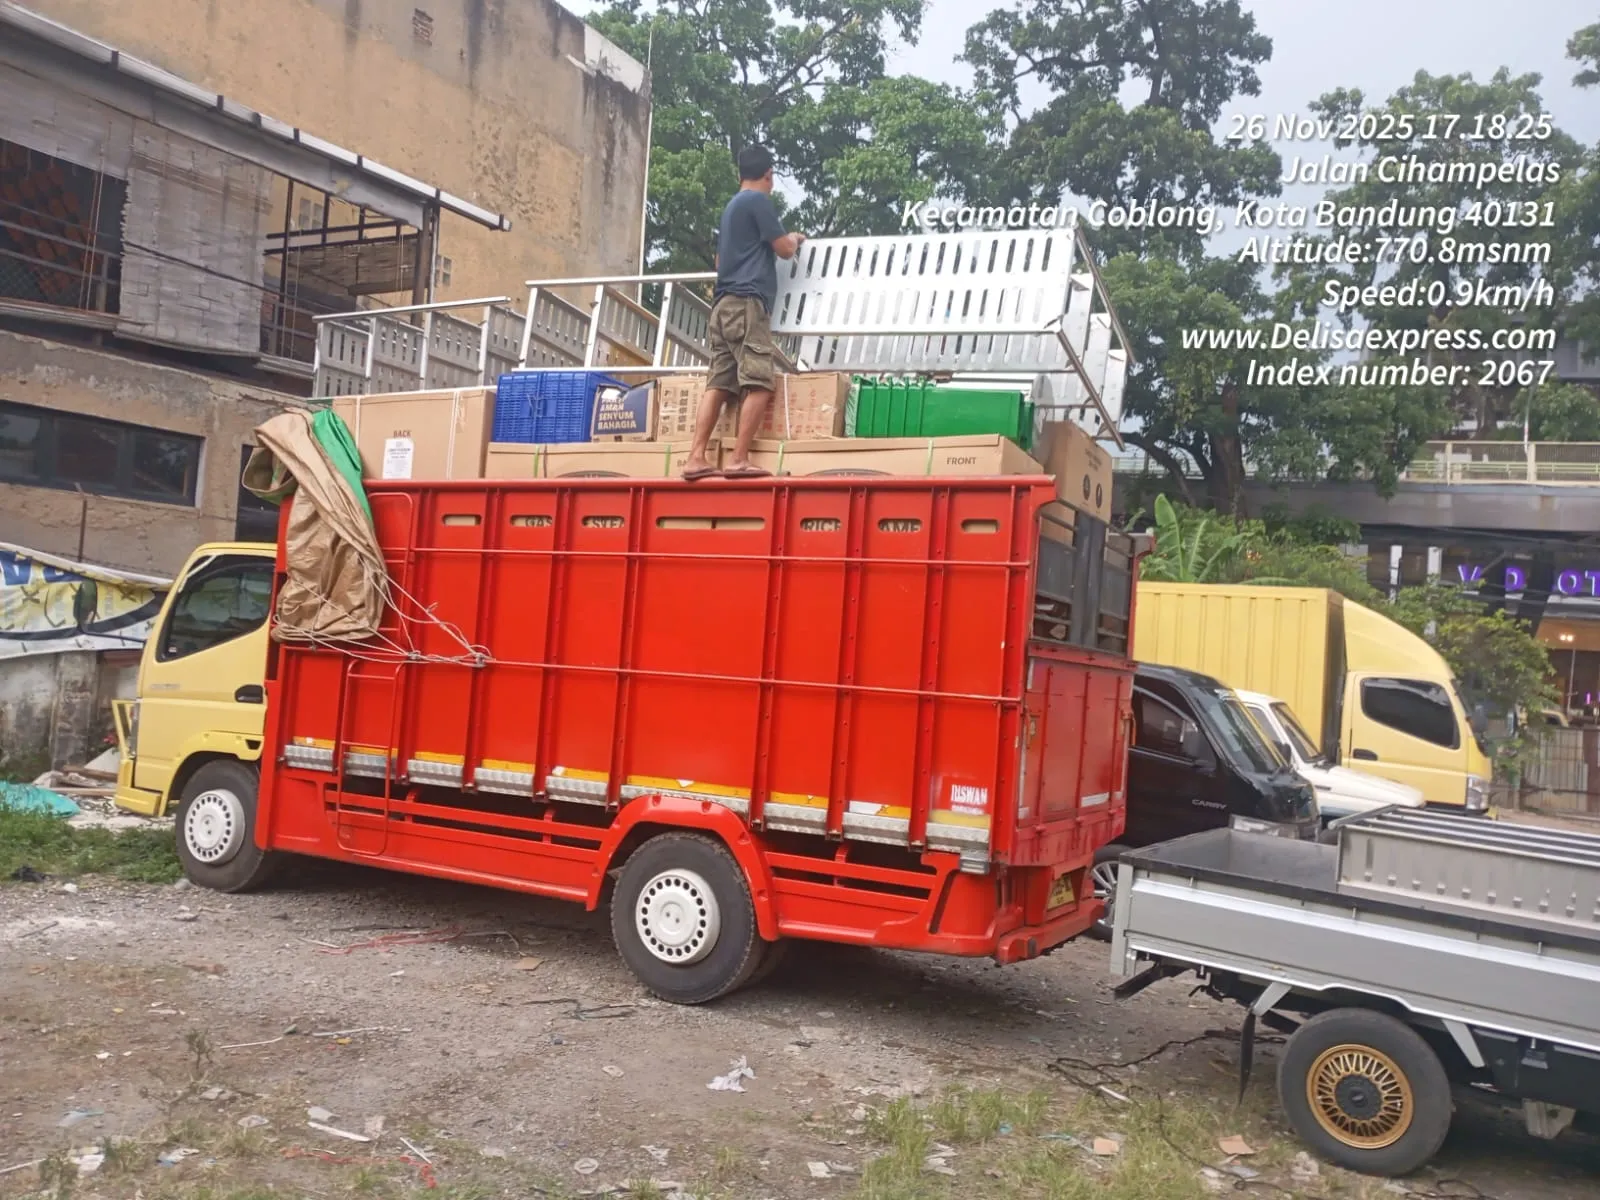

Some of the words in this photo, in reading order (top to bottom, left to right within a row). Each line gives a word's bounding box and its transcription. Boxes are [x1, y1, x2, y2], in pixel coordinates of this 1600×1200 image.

[599, 411, 634, 421] SENYUM
[597, 420, 637, 430] BAHAGIA
[946, 456, 977, 465] FRONT
[1191, 799, 1228, 810] CARRY
